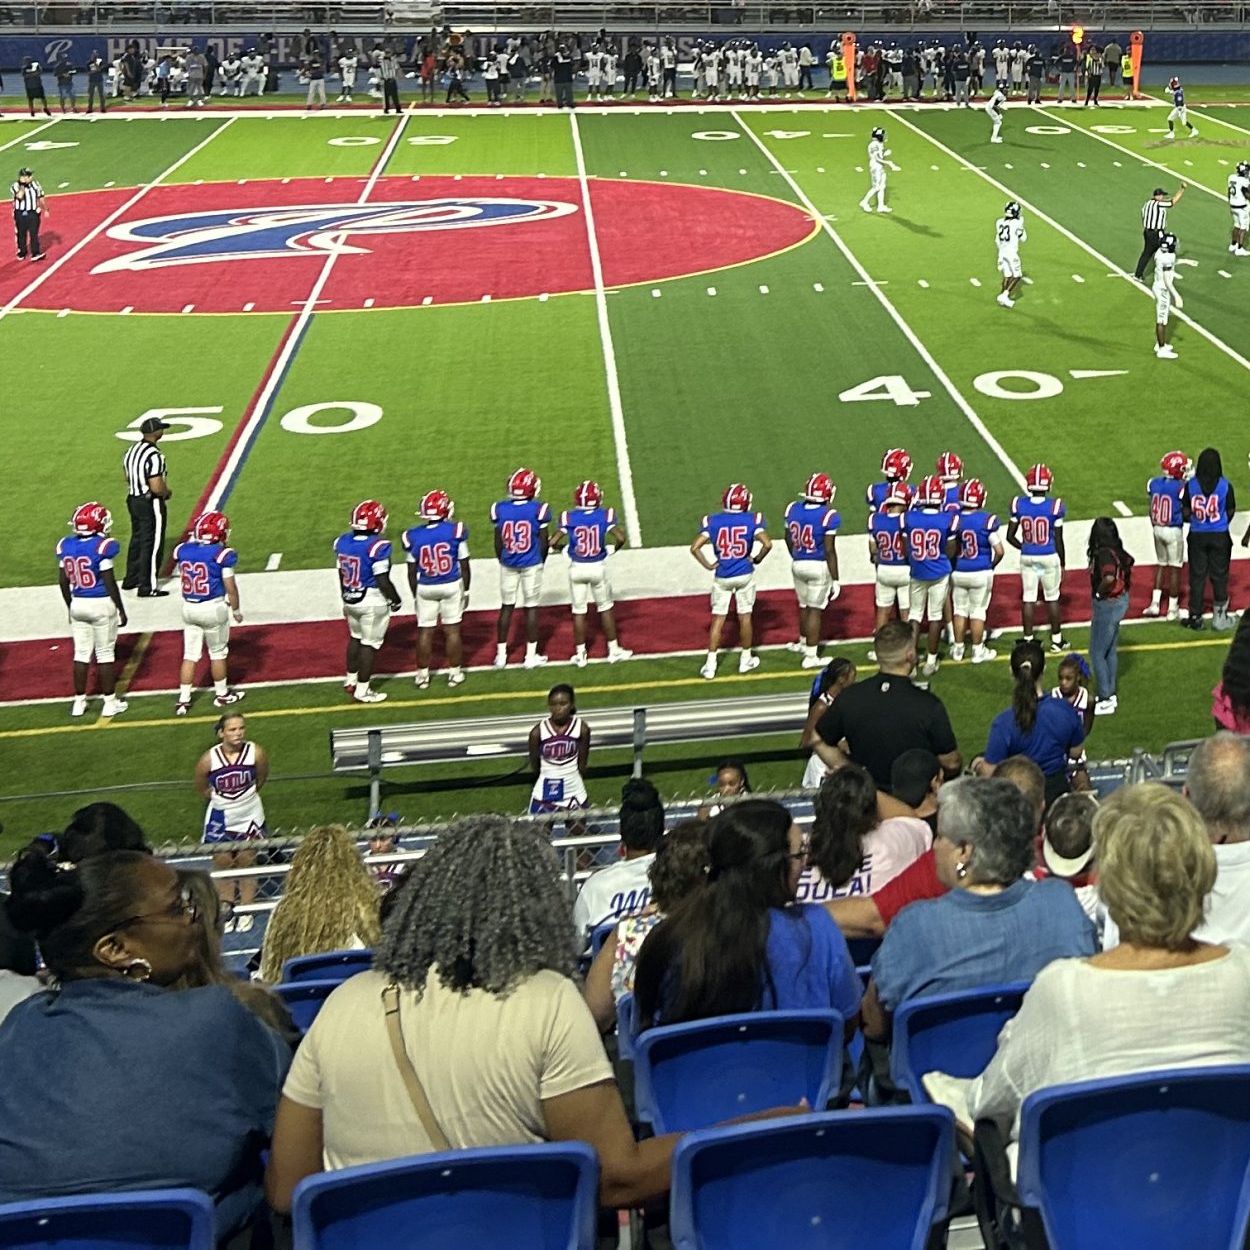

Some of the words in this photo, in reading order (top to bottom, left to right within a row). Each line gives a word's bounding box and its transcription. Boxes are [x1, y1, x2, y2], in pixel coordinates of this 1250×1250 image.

[998, 224, 1012, 242] 23
[1151, 493, 1172, 525] 40
[1191, 494, 1220, 523] 64
[502, 520, 531, 554] 43
[575, 525, 600, 557] 31
[716, 525, 748, 560] 45
[910, 528, 942, 561] 93
[958, 529, 979, 560] 3
[1020, 515, 1049, 545] 80
[418, 542, 452, 577] 46
[180, 560, 210, 596] 62
